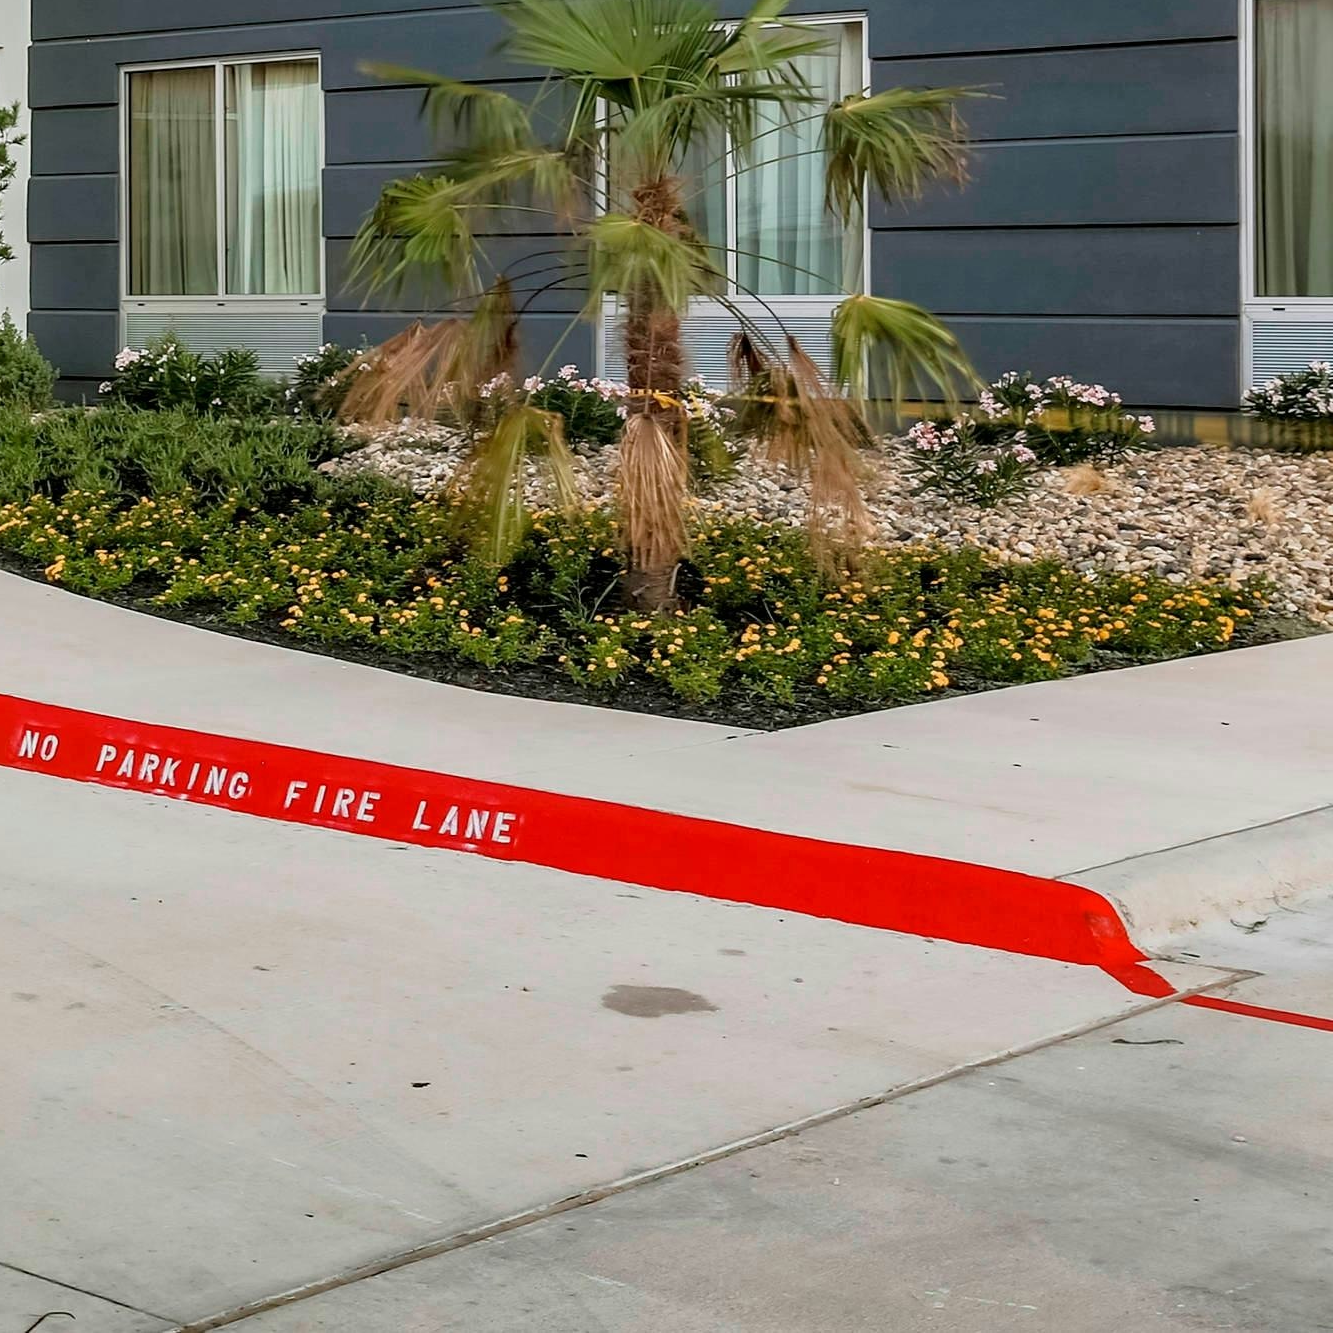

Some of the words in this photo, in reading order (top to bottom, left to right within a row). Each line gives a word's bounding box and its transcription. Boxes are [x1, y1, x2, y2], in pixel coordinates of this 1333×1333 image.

[17, 729, 59, 762] NO
[95, 744, 249, 800] PARKING
[284, 780, 381, 823] FIRE
[412, 800, 517, 844] LANE
